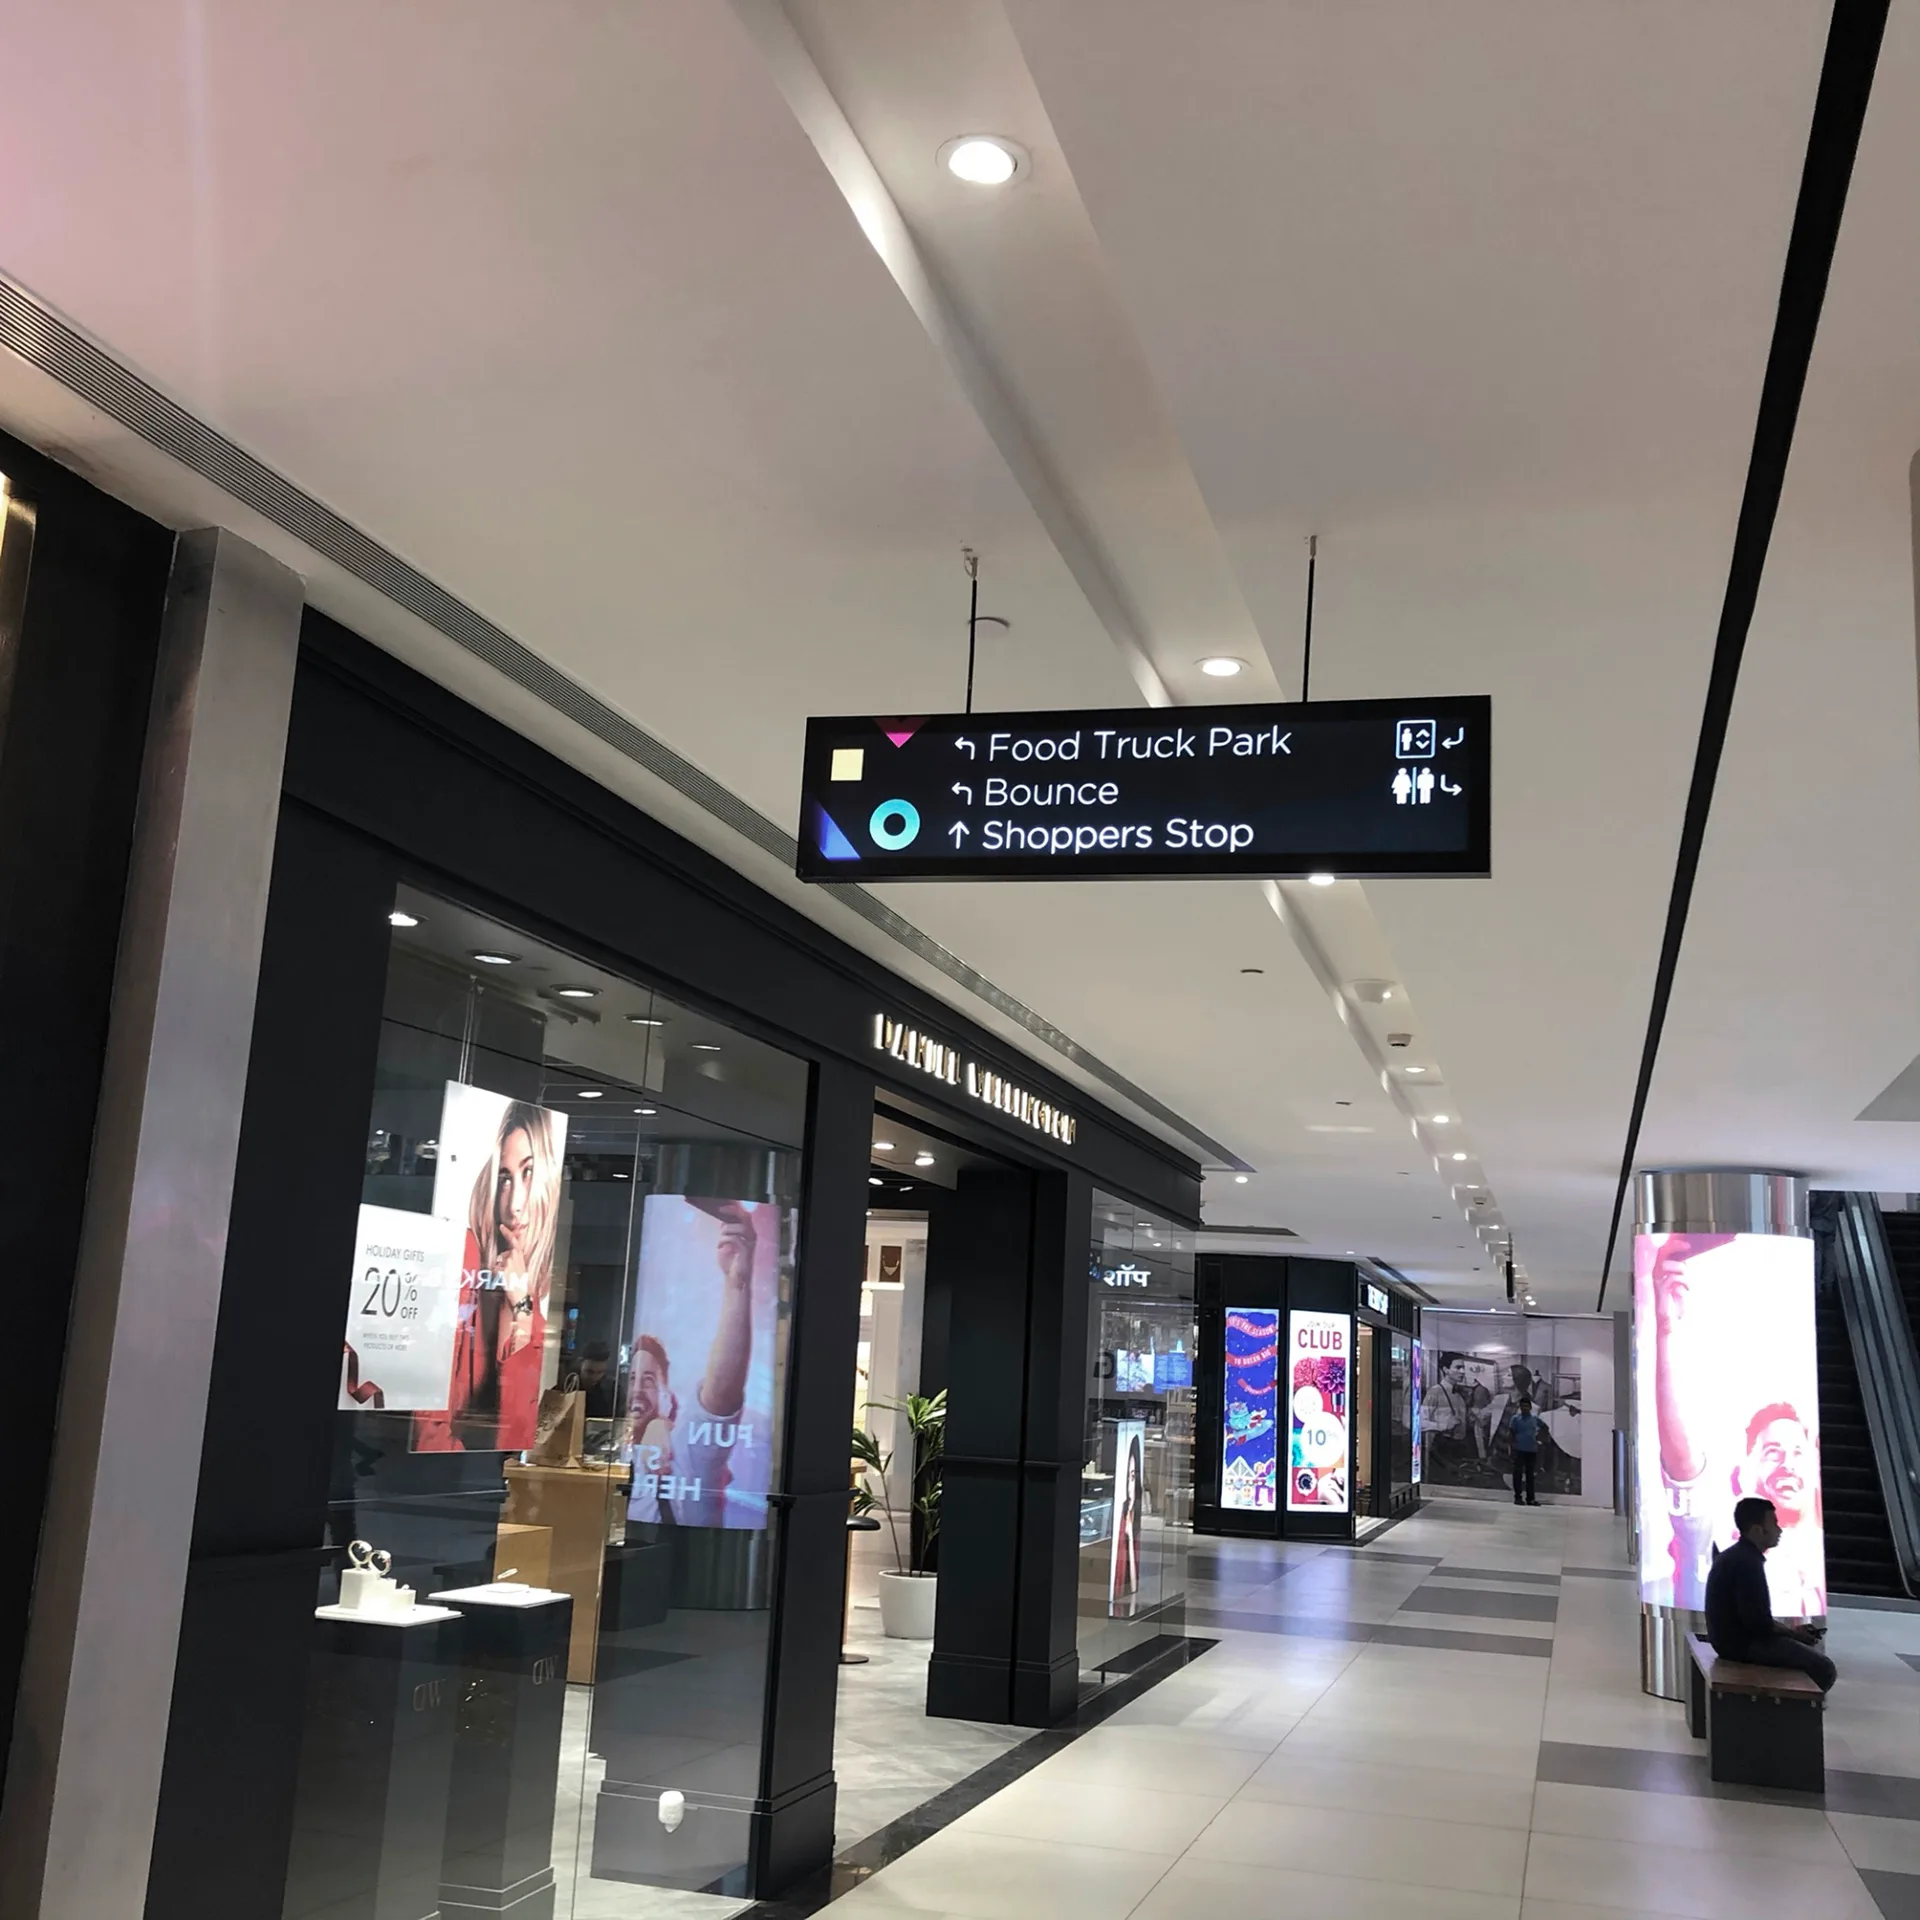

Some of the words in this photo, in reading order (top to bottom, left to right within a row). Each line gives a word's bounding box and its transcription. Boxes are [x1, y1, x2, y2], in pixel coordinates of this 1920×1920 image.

[989, 730, 1081, 762] Food
[1093, 727, 1196, 760] Truck
[1208, 724, 1292, 757] Park
[985, 777, 1119, 807] Bounce
[981, 819, 1153, 855] Shoppers
[1164, 817, 1254, 853] Stop
[365, 1244, 401, 1259] HOLIDAY
[403, 1249, 425, 1262] GIFTS
[400, 1306, 418, 1320] OFF
[1297, 1328, 1343, 1350] CLUB
[1307, 1429, 1327, 1446] 10
